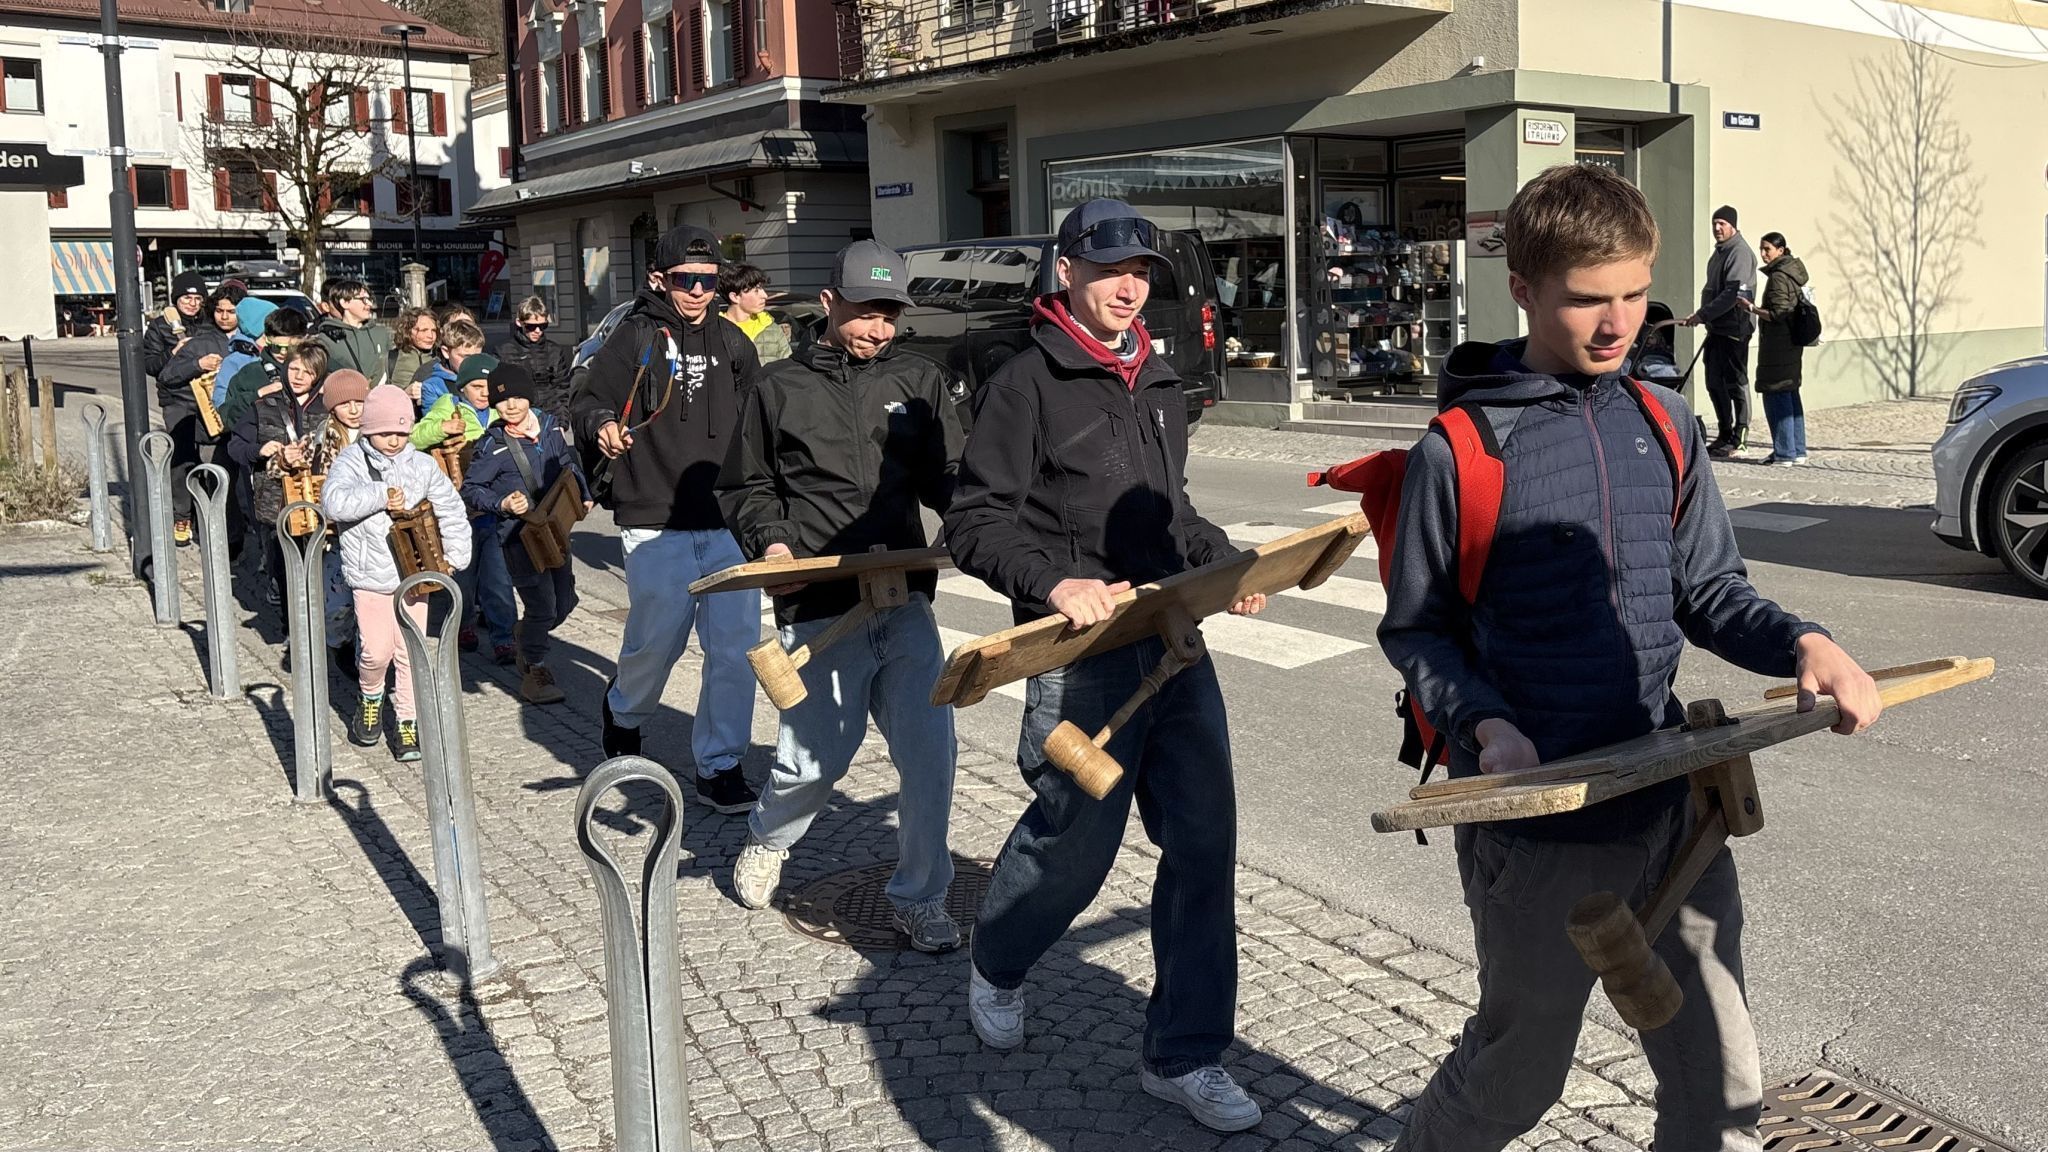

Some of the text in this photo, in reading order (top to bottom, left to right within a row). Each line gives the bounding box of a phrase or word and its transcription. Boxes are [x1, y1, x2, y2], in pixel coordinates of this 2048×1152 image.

[1528, 121, 1560, 131] RISTORANTE
[1527, 131, 1560, 140] ITALIANO
[0, 150, 39, 168] den
[325, 241, 367, 249] MINERALIEN
